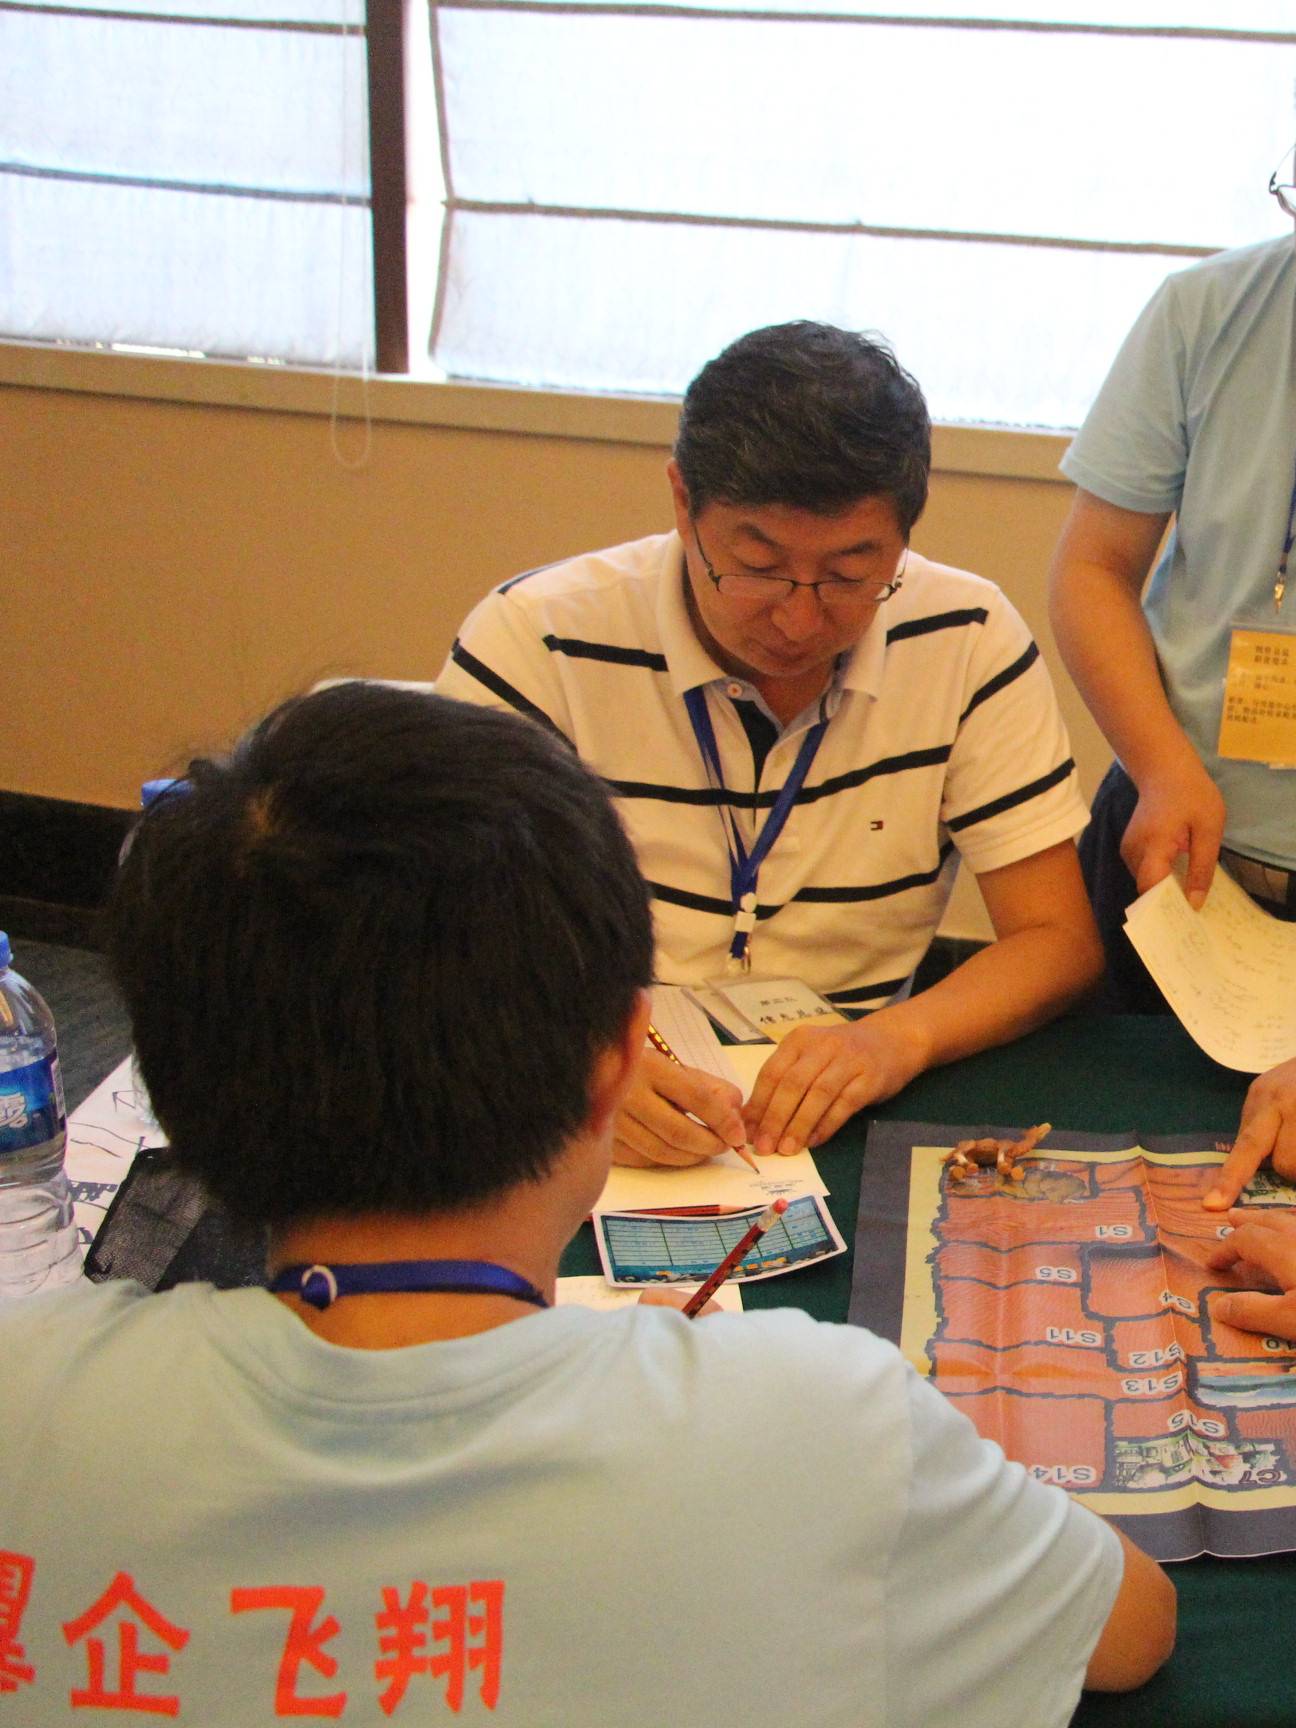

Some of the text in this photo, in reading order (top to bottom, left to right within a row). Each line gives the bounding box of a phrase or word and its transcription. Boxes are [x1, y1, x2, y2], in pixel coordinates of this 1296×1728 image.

[1097, 1225, 1130, 1237] S1
[1038, 1267, 1074, 1280] S5
[1161, 1291, 1193, 1310] S4
[1049, 1328, 1098, 1345] S11
[1131, 1343, 1184, 1368] S12
[1124, 1374, 1181, 1392] S13
[1170, 1412, 1224, 1435] S15
[1031, 1466, 1093, 1481] S14
